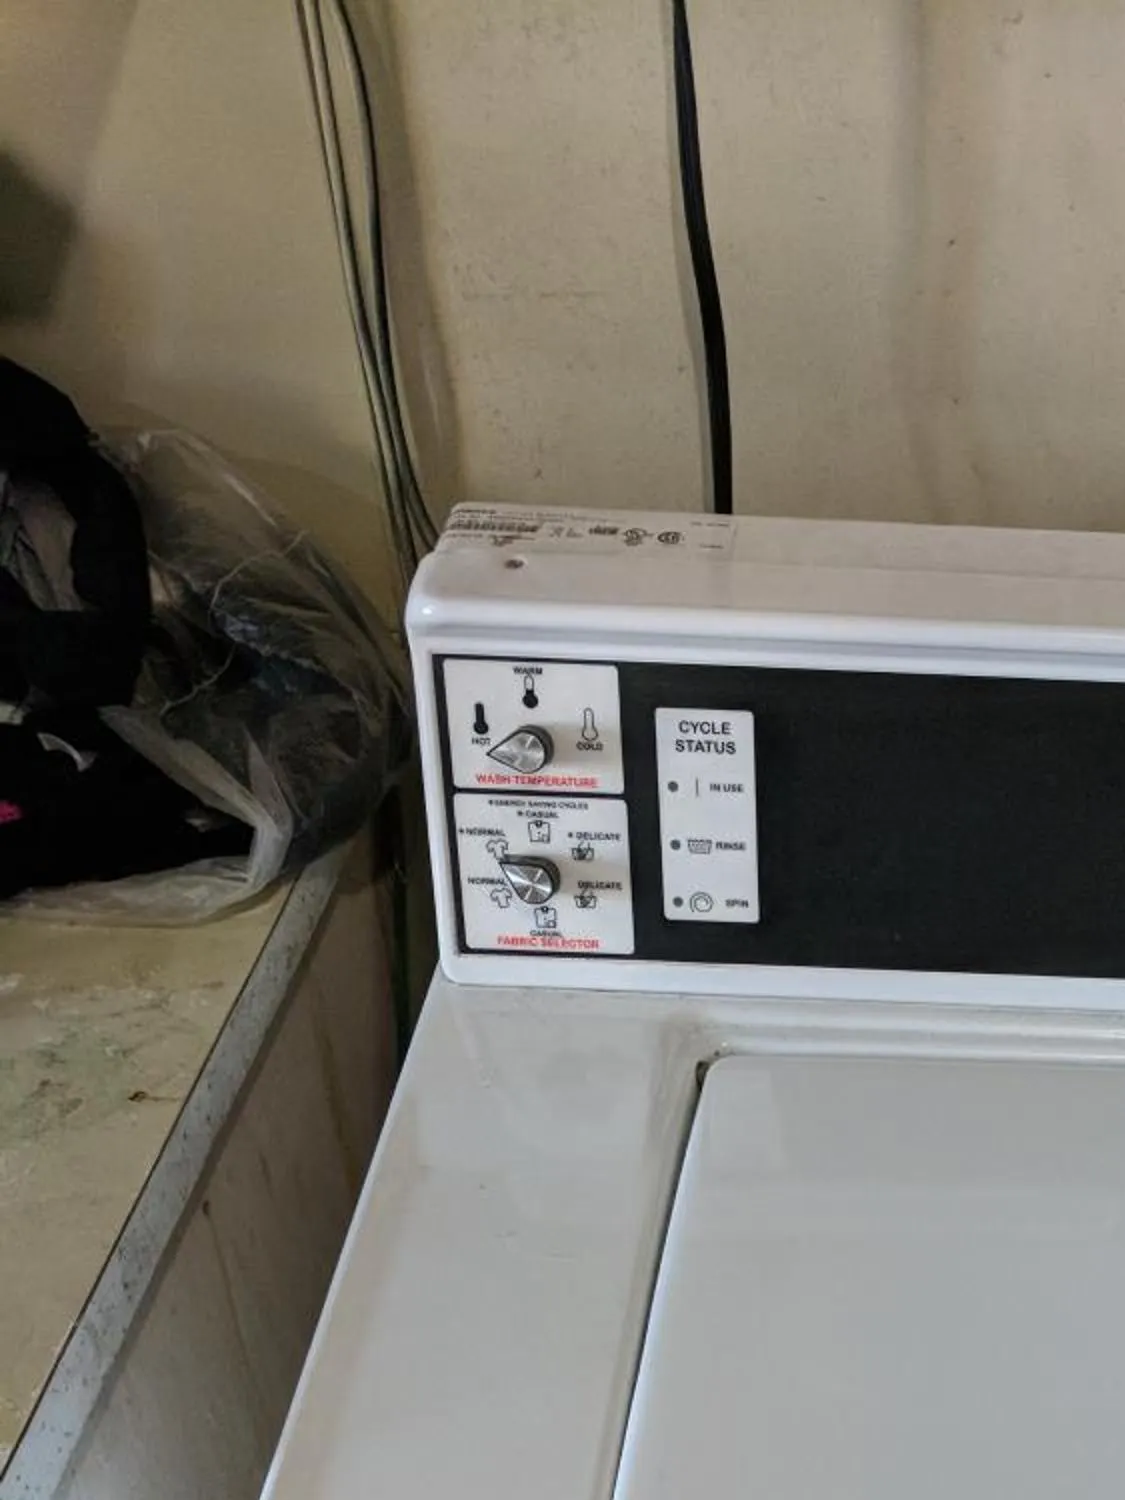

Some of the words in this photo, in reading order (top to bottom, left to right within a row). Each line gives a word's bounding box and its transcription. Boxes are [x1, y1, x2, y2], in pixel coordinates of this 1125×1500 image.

[513, 667, 543, 675] WARM
[678, 719, 732, 736] CYCLE
[471, 737, 491, 745] HOT
[576, 742, 603, 751] COLD
[675, 739, 737, 755] STATUS
[476, 774, 512, 785] WASH
[515, 775, 598, 788] TEMPERATURE
[709, 783, 721, 793] IN
[723, 783, 745, 793] USE
[526, 810, 559, 819] CASUAL
[466, 828, 506, 837] NORMAL
[576, 832, 621, 842] DELICATE
[715, 841, 747, 851] RINSE
[468, 877, 507, 886] NORMAL
[578, 880, 622, 890] DELICATE
[725, 899, 750, 909] SPIN
[497, 936, 538, 947] FABRIC
[541, 937, 599, 949] SELECTOR
